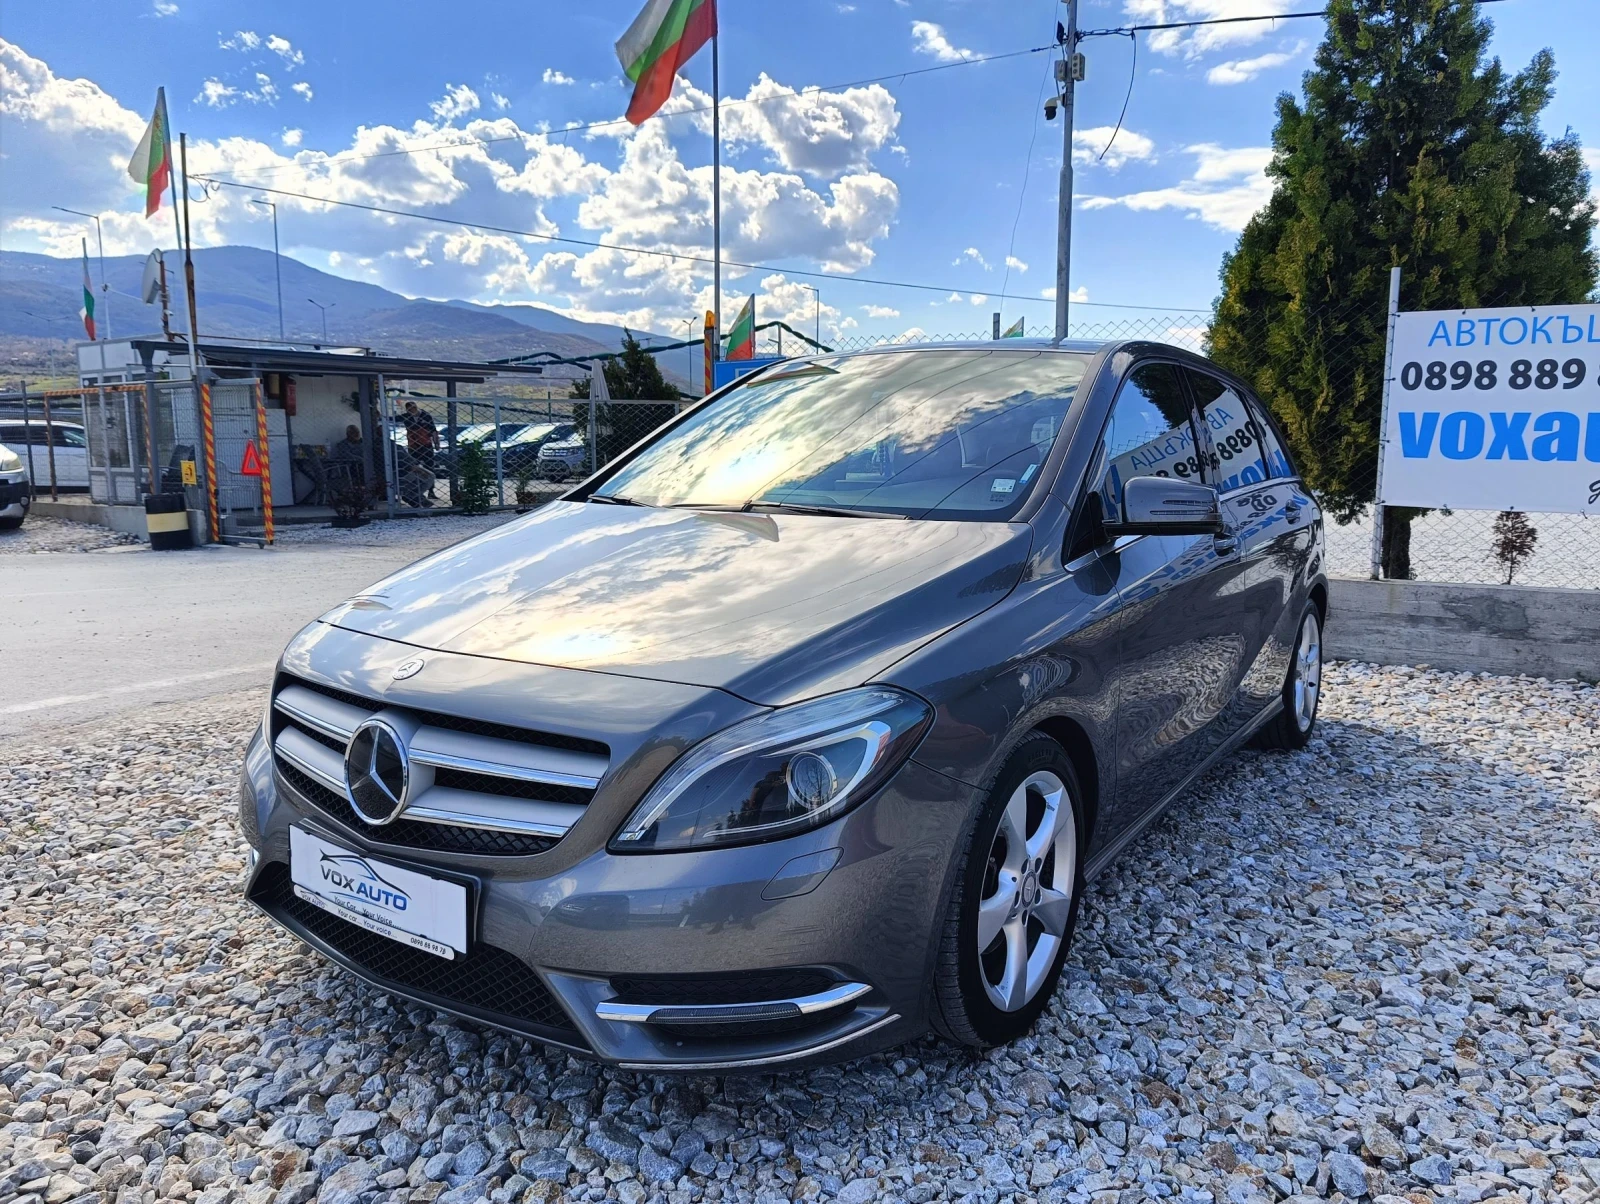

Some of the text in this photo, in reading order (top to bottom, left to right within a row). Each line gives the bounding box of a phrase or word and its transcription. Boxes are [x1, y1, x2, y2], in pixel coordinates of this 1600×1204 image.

[1401, 360, 1498, 390] 0898
[1508, 358, 1586, 390] 889
[320, 864, 408, 911] VOX AUTO
